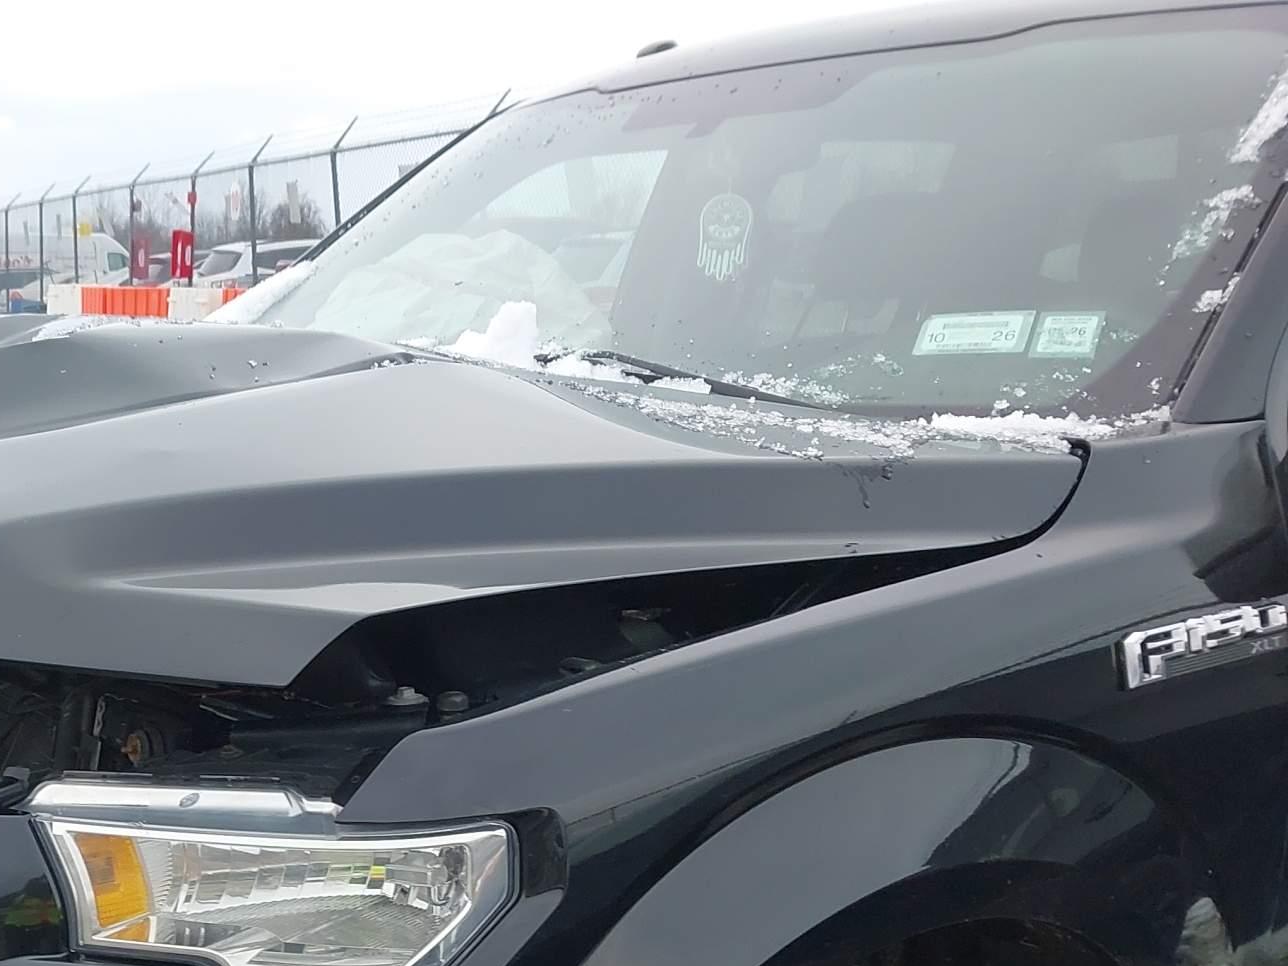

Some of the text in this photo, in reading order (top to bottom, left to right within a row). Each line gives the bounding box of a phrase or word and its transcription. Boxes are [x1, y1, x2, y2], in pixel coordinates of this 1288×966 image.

[927, 330, 1017, 344] 10 26
[1249, 635, 1283, 655] XLT
